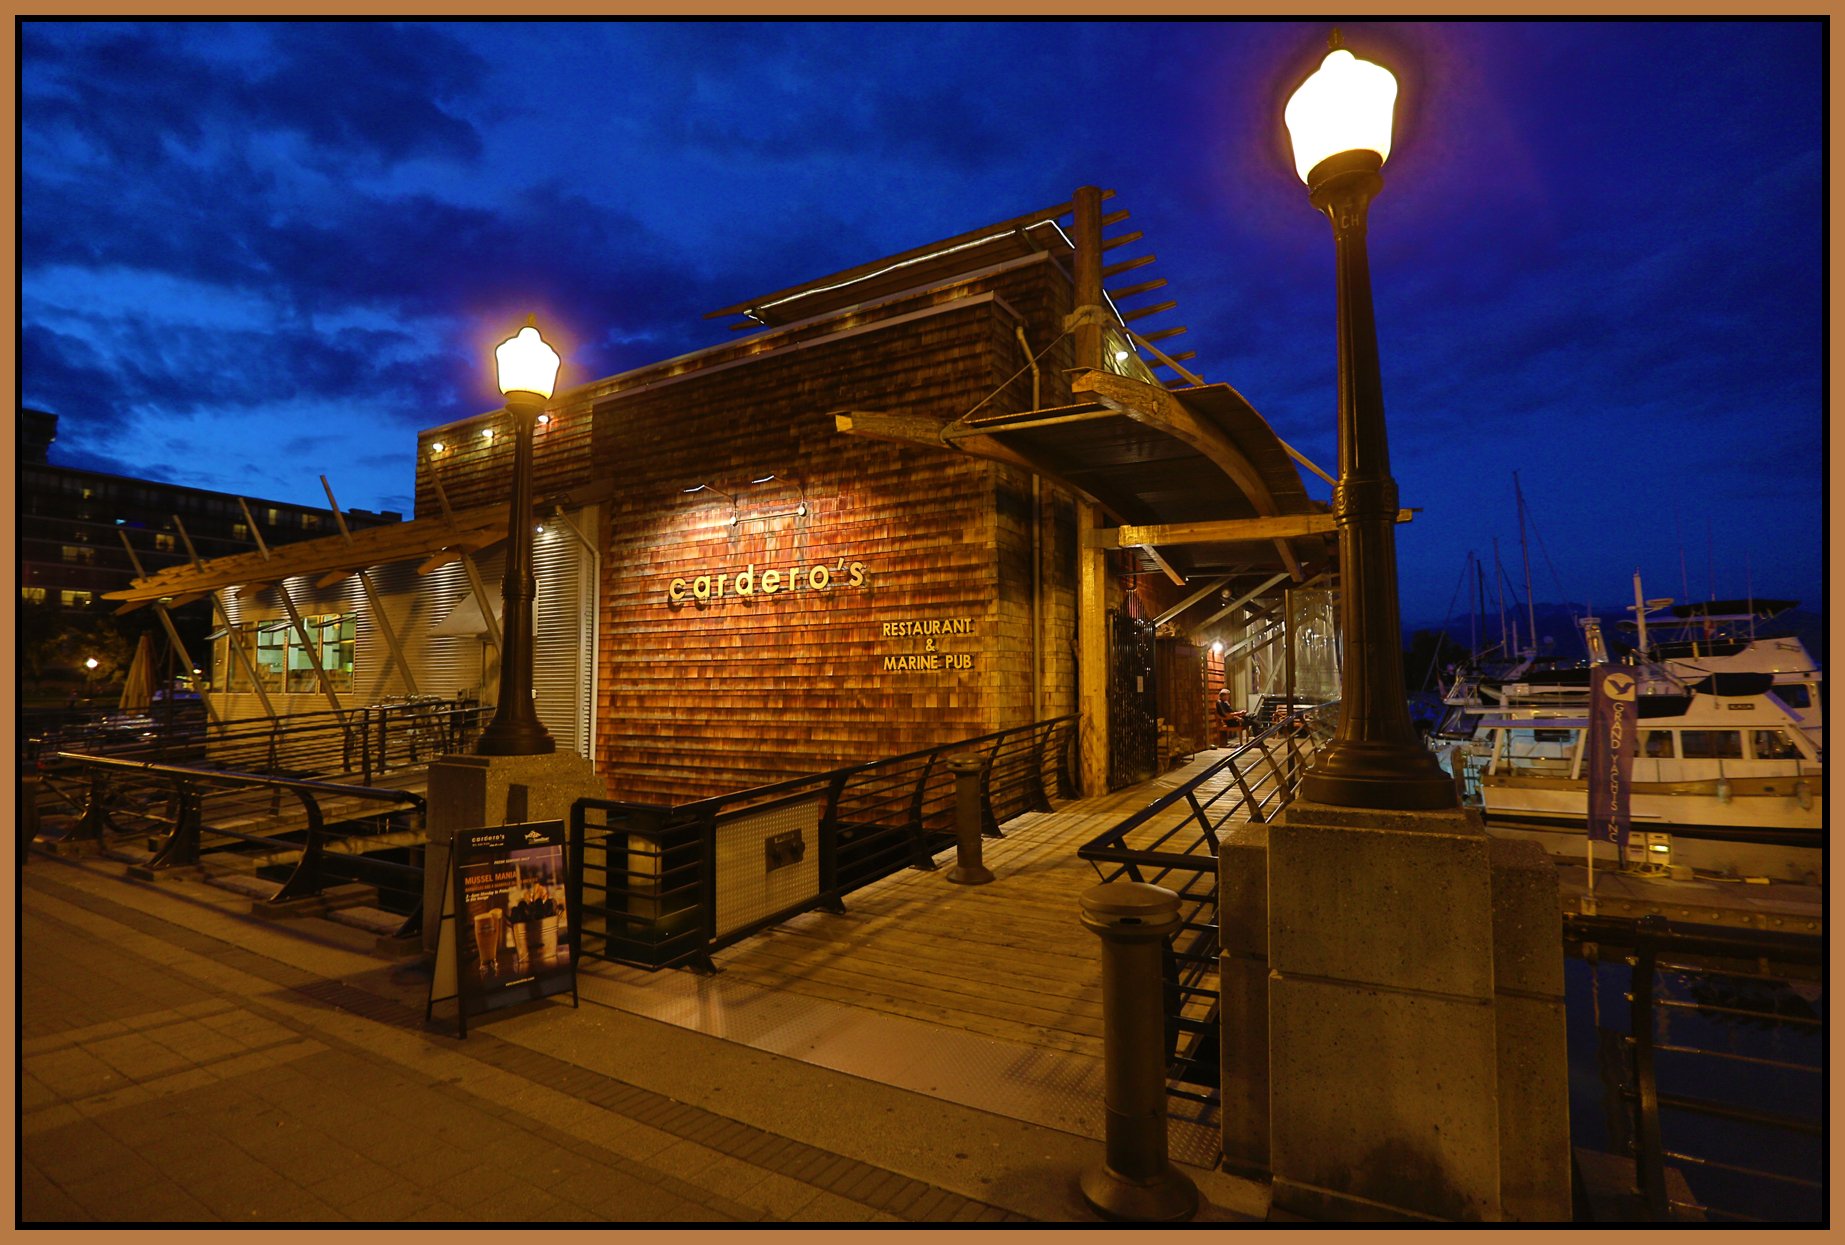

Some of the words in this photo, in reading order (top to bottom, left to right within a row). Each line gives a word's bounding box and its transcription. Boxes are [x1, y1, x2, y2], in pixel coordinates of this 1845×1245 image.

[1341, 213, 1359, 229] CH
[669, 557, 864, 599] cardero's
[882, 618, 972, 636] RESTAURANT
[925, 638, 936, 652] &
[883, 655, 938, 670] MARINE
[945, 654, 972, 669] PUB
[1611, 702, 1624, 749] GRAND
[1610, 754, 1620, 811] YACHTS
[1607, 815, 1619, 842] INC
[465, 875, 493, 886] MUSSEL
[495, 871, 517, 881] MANIA
